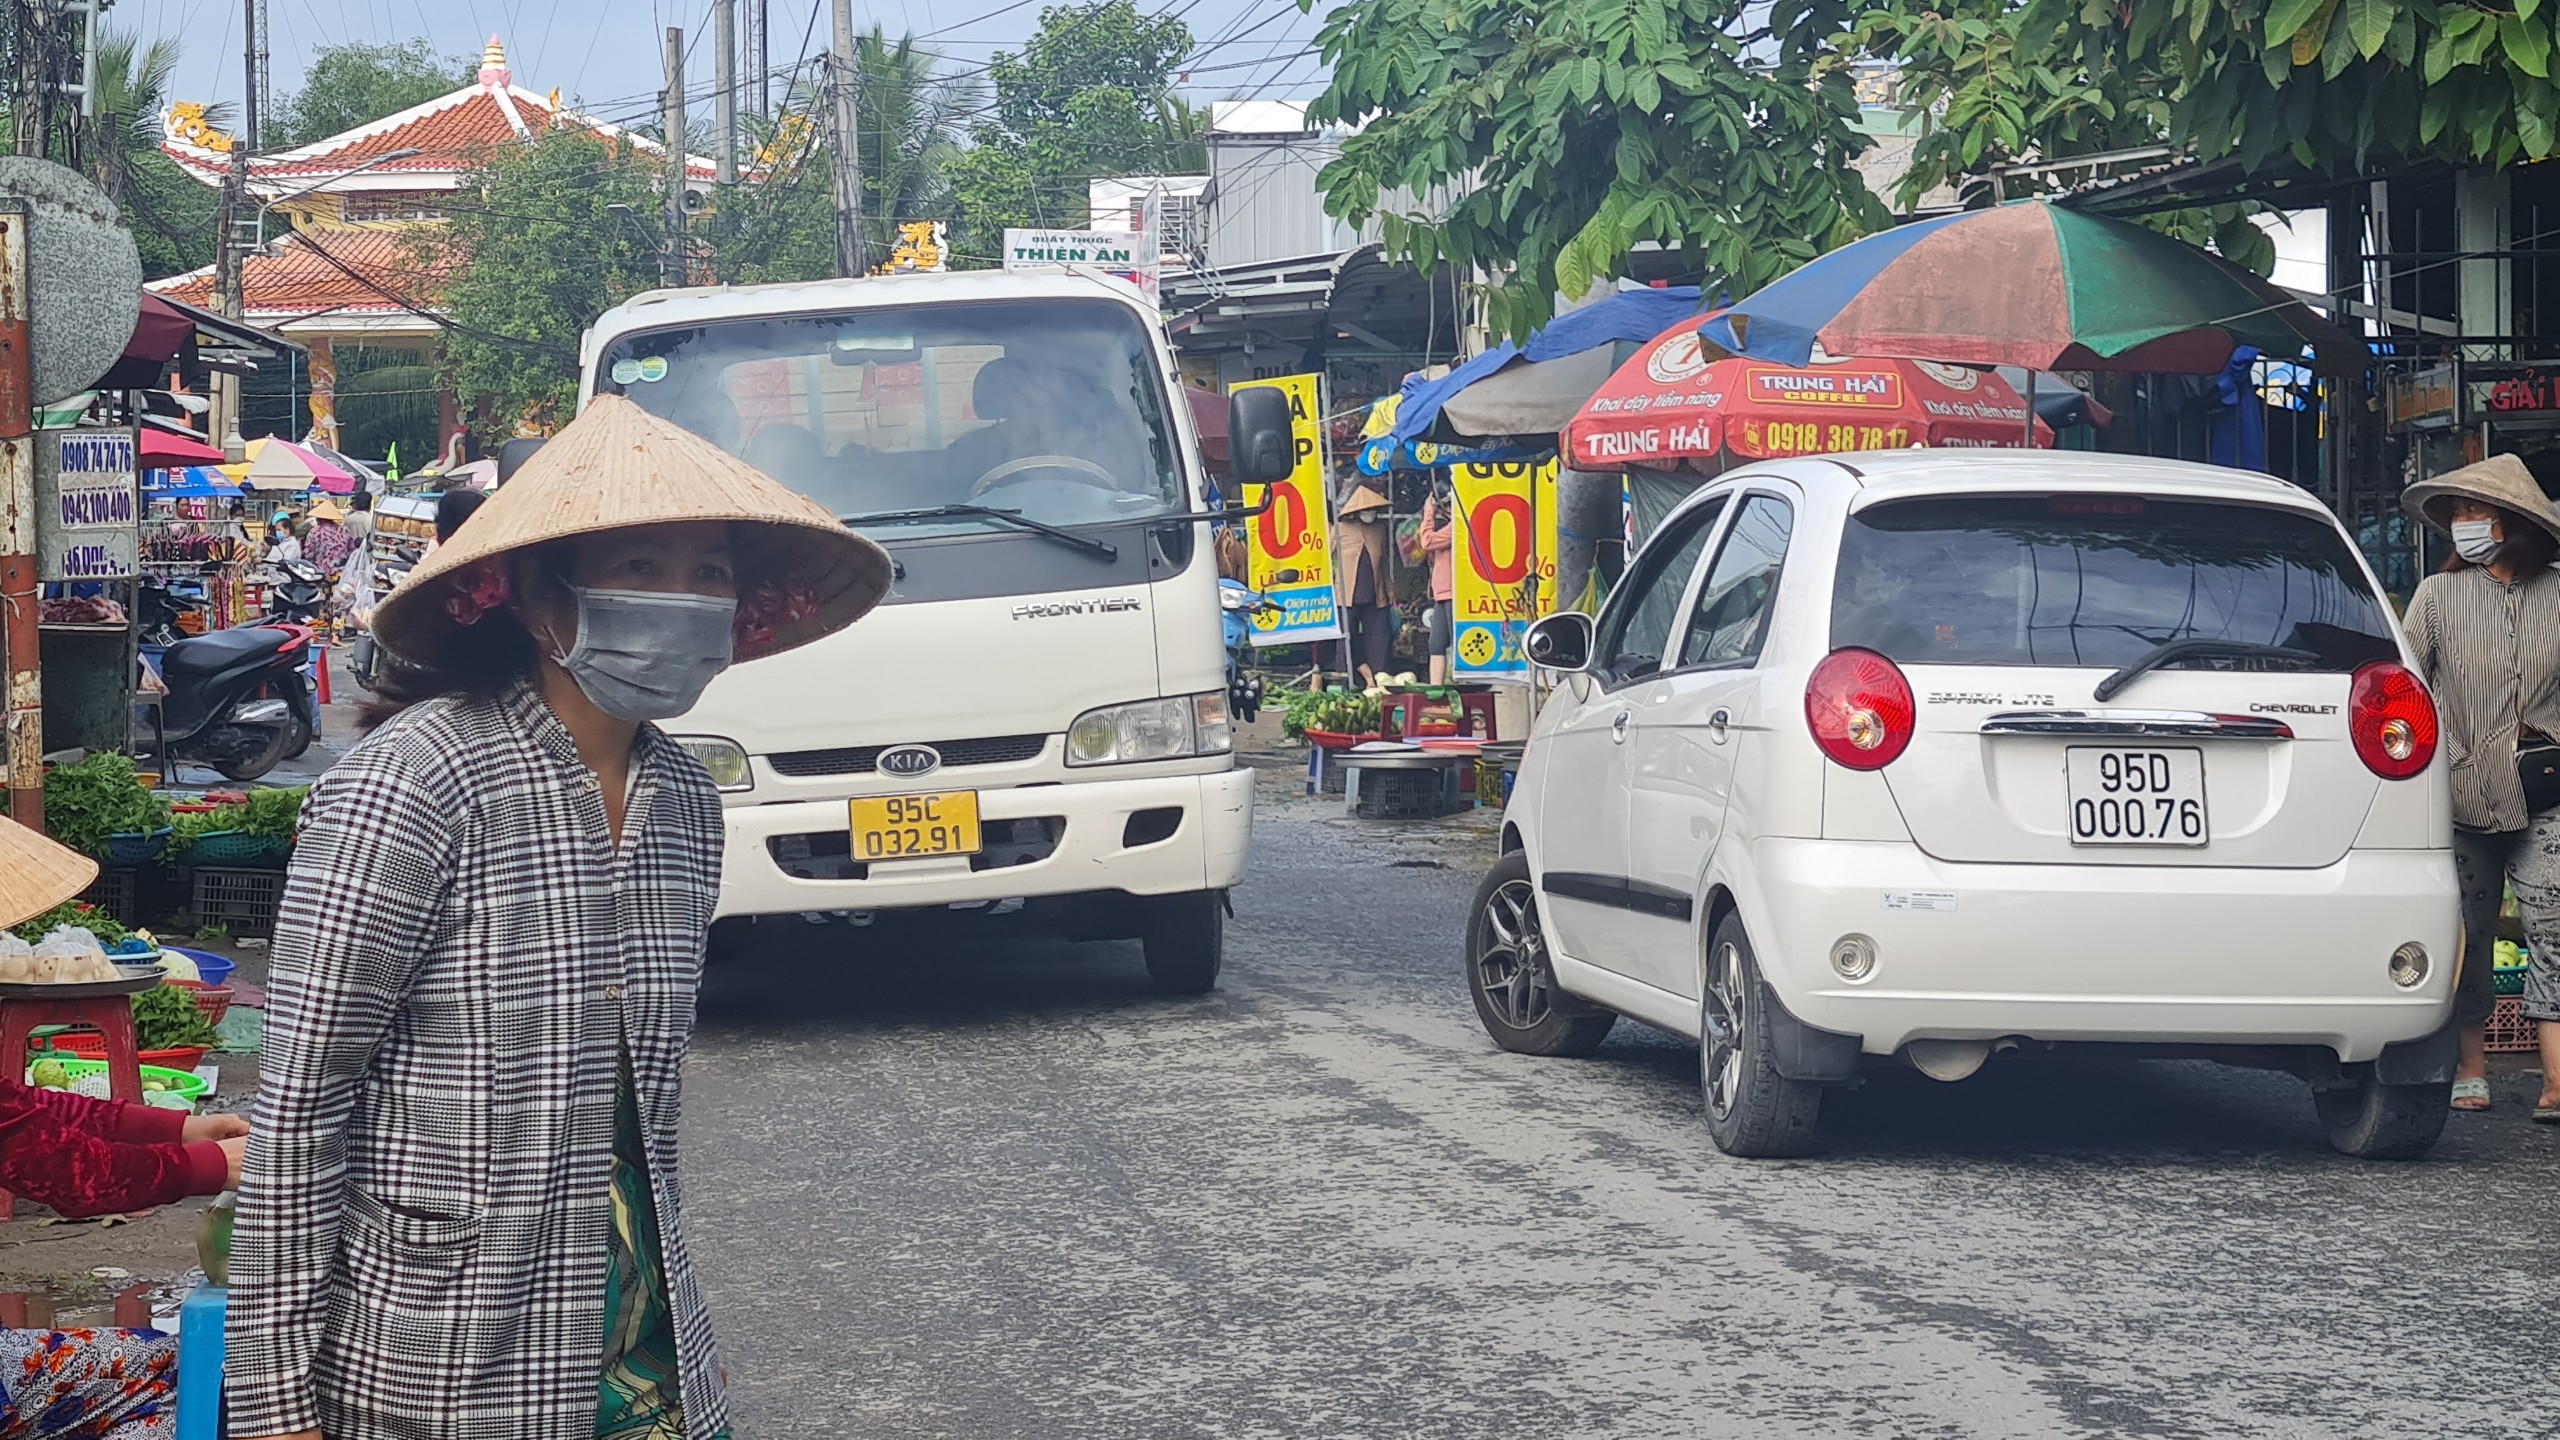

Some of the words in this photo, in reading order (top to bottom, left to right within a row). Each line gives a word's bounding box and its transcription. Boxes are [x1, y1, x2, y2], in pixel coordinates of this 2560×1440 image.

[1014, 246, 1086, 261] THIÊN
[1095, 246, 1130, 262] ÂN
[1758, 375, 1834, 392] TRUNG
[1844, 373, 1887, 394] HẢI
[1684, 391, 1723, 408] năng
[1783, 390, 1868, 403] COFFEE
[1585, 428, 1661, 456] TRUNG
[1669, 418, 1710, 451] HẢI
[1766, 421, 1823, 452] 0918.
[1827, 423, 1856, 453] 38
[1859, 426, 1884, 451] 78
[1886, 428, 1909, 450] 17
[62, 441, 131, 473] 0908.74.74.76
[61, 491, 131, 525] 0942.100.400
[1011, 596, 1142, 621] FRONTIER
[1468, 595, 1499, 614] LÃI
[1283, 607, 1333, 627] XANH
[2011, 693, 2056, 706] LITE
[2249, 702, 2340, 715] CHEVROLET
[889, 753, 929, 771] KIA
[2100, 753, 2171, 793] 95D
[886, 796, 942, 824] 95C
[2075, 798, 2201, 838] 000.76
[866, 825, 962, 857] 032.91
